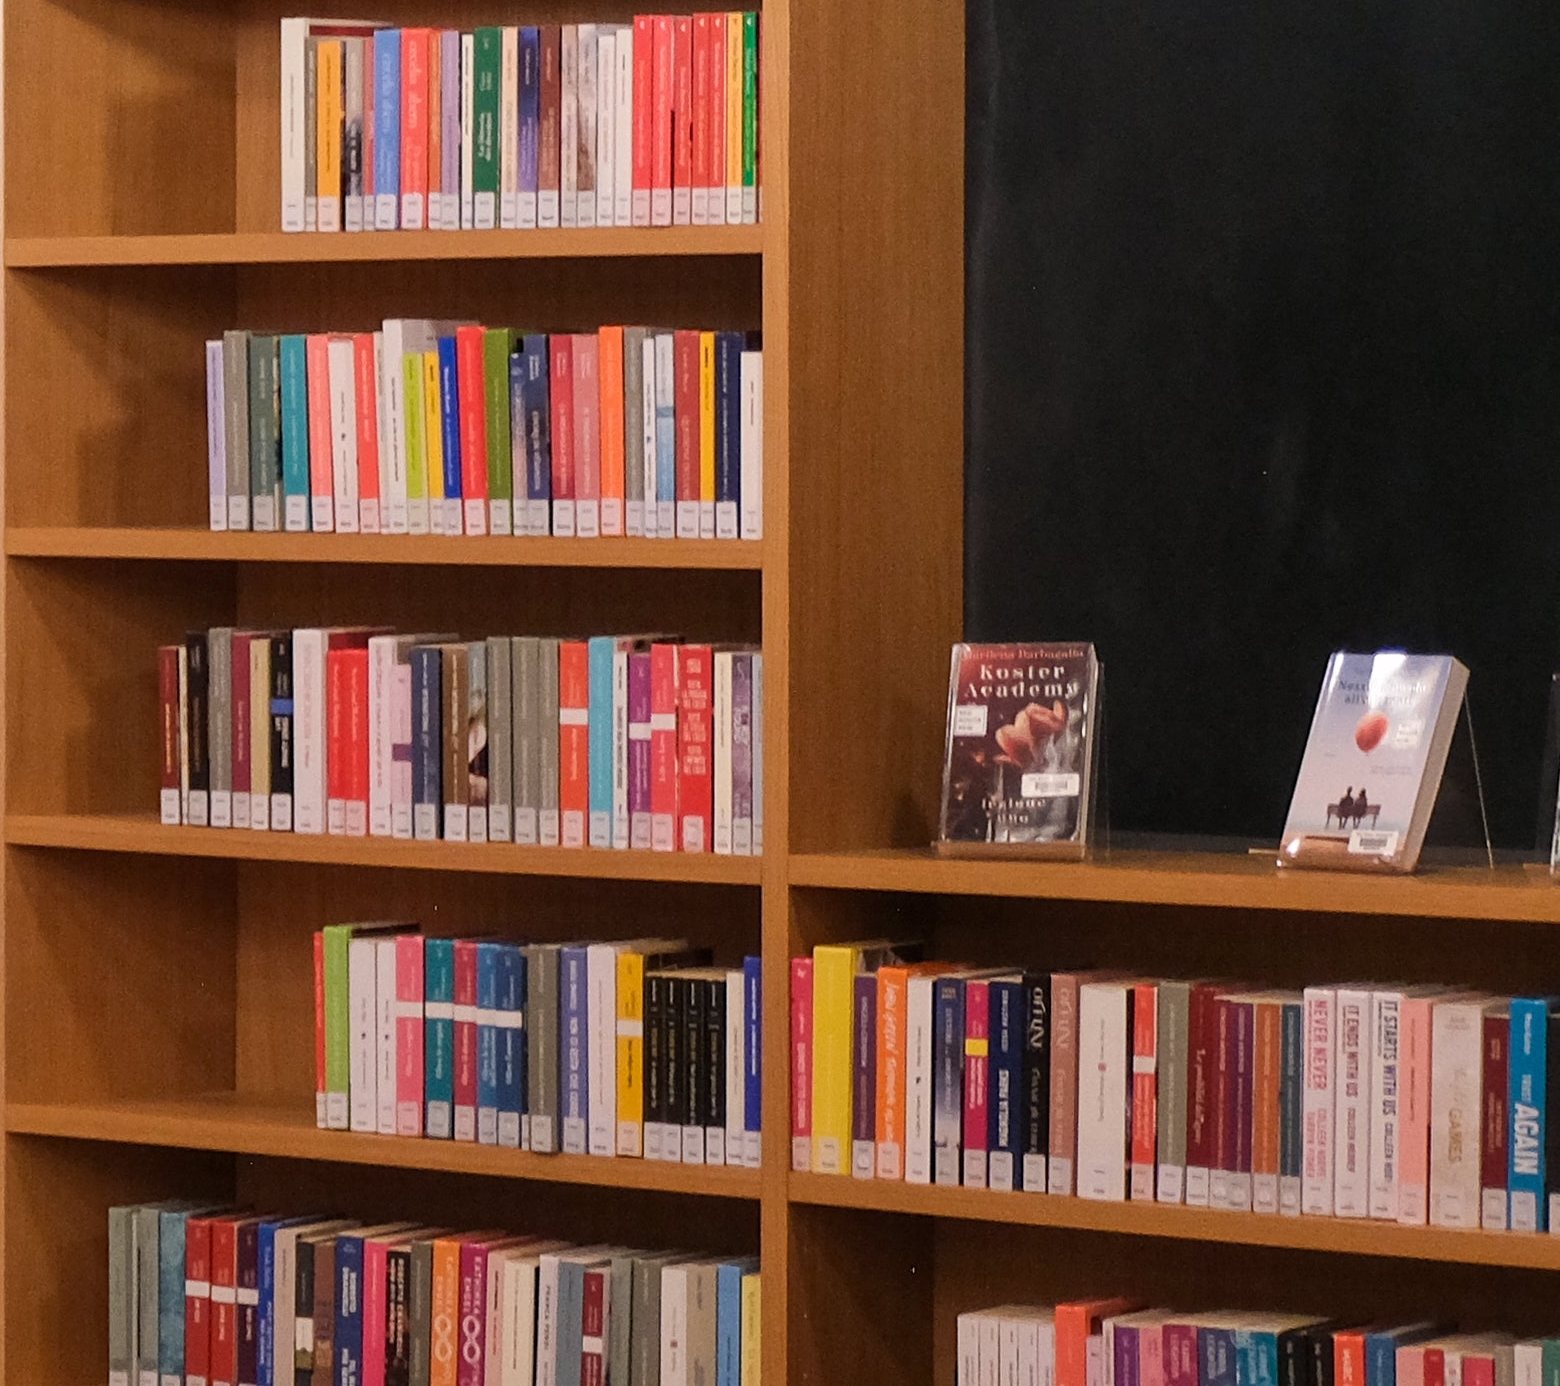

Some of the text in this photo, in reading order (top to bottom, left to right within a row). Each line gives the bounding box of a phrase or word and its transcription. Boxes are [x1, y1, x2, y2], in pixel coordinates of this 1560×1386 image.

[966, 681, 1080, 699] Academy
[980, 664, 1065, 679] Koster
[1314, 1000, 1328, 1090] NEVER NEVER
[1346, 1005, 1360, 1098] IT ENDS WITH US
[1383, 1000, 1398, 1116] IT STARTS WITH US
[1514, 1102, 1539, 1175] AGAIN
